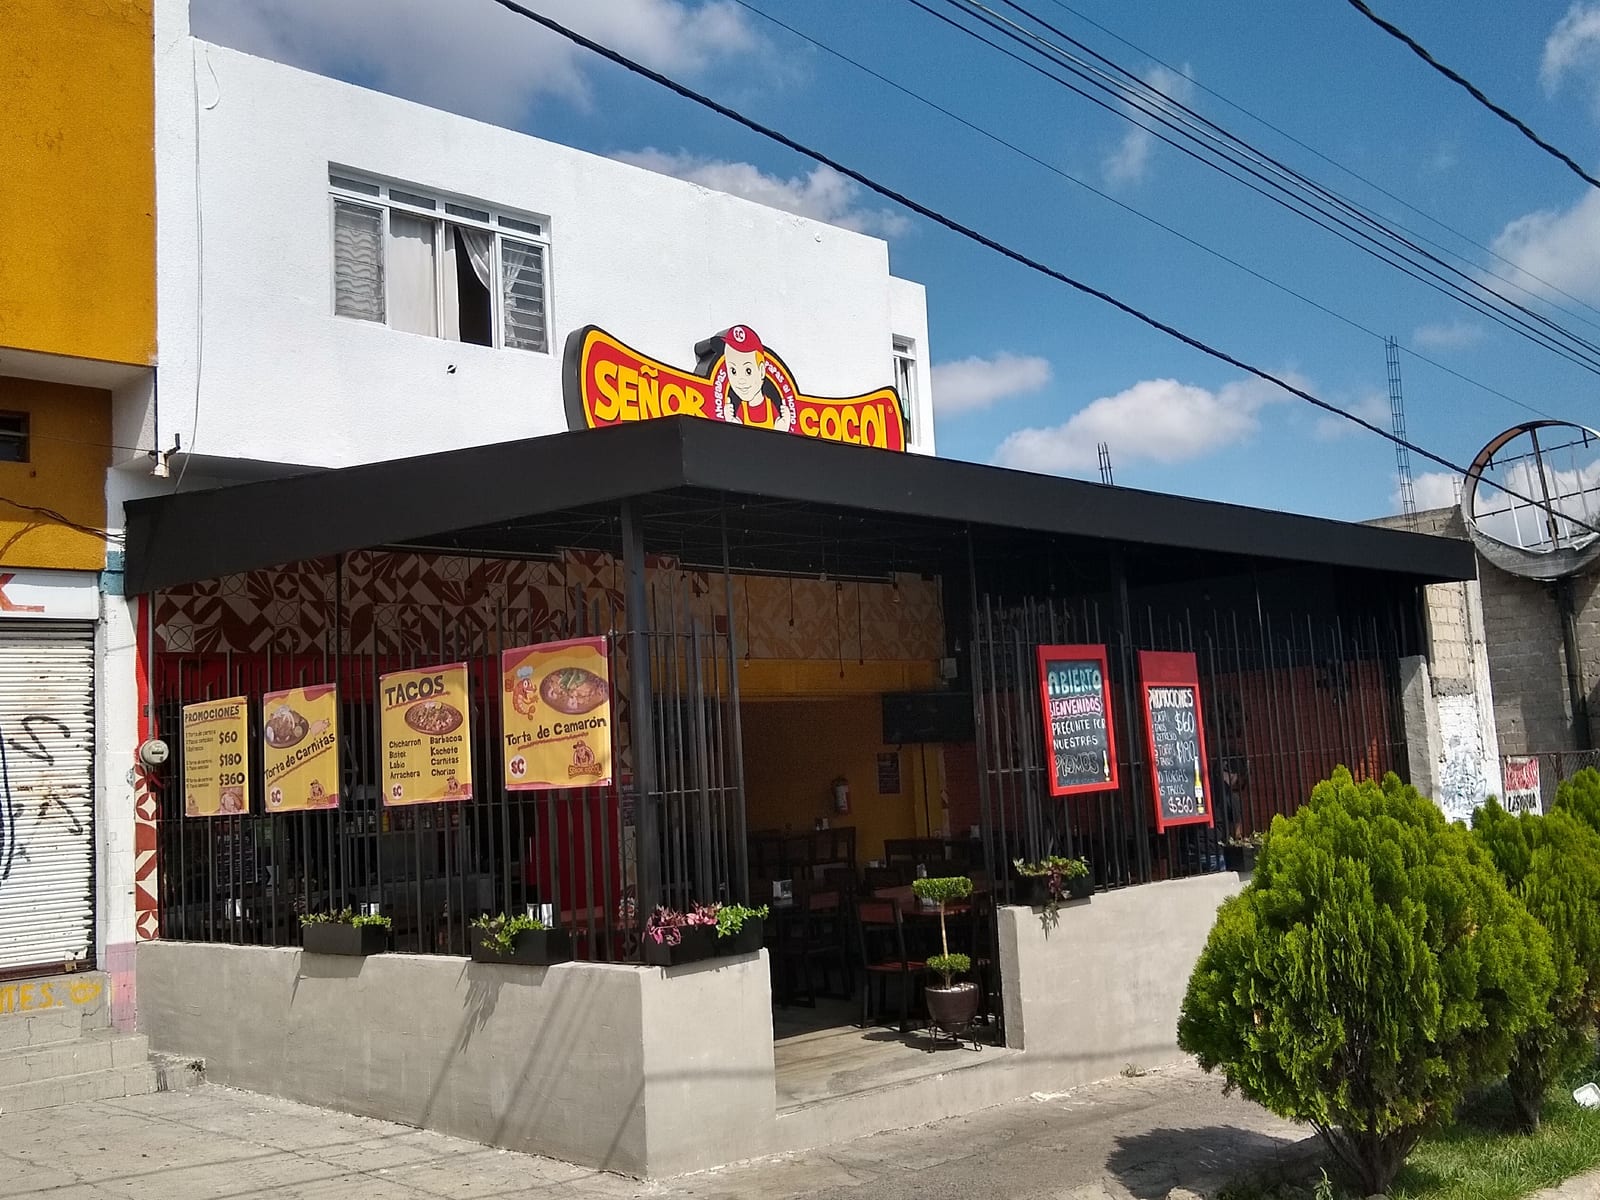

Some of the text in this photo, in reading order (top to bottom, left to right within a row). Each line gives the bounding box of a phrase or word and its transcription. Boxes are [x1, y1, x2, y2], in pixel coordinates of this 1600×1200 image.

[594, 359, 709, 421] SEÑOR
[799, 403, 888, 449] COCOI
[385, 674, 445, 706] TACOS
[1048, 669, 1102, 695] ABIERTO
[184, 705, 240, 723] PROMOCIONES
[1174, 710, 1195, 735] $60
[506, 716, 607, 746] Torta de Camarón
[1051, 719, 1090, 736] PREGUNTE
[219, 730, 238, 746] $60
[430, 735, 463, 745] Barbacoa
[1053, 735, 1099, 751] NUESTRAS
[219, 752, 242, 768] $180
[264, 732, 336, 780] Torta de Carnitas
[430, 757, 460, 766] Carnitas
[1055, 751, 1100, 777] PROMOS
[431, 768, 456, 777] Chorizo
[511, 758, 525, 775] SC
[219, 772, 246, 787] $360
[271, 789, 281, 803] SC
[1168, 796, 1194, 814] $360
[0, 983, 63, 1013] TES.
